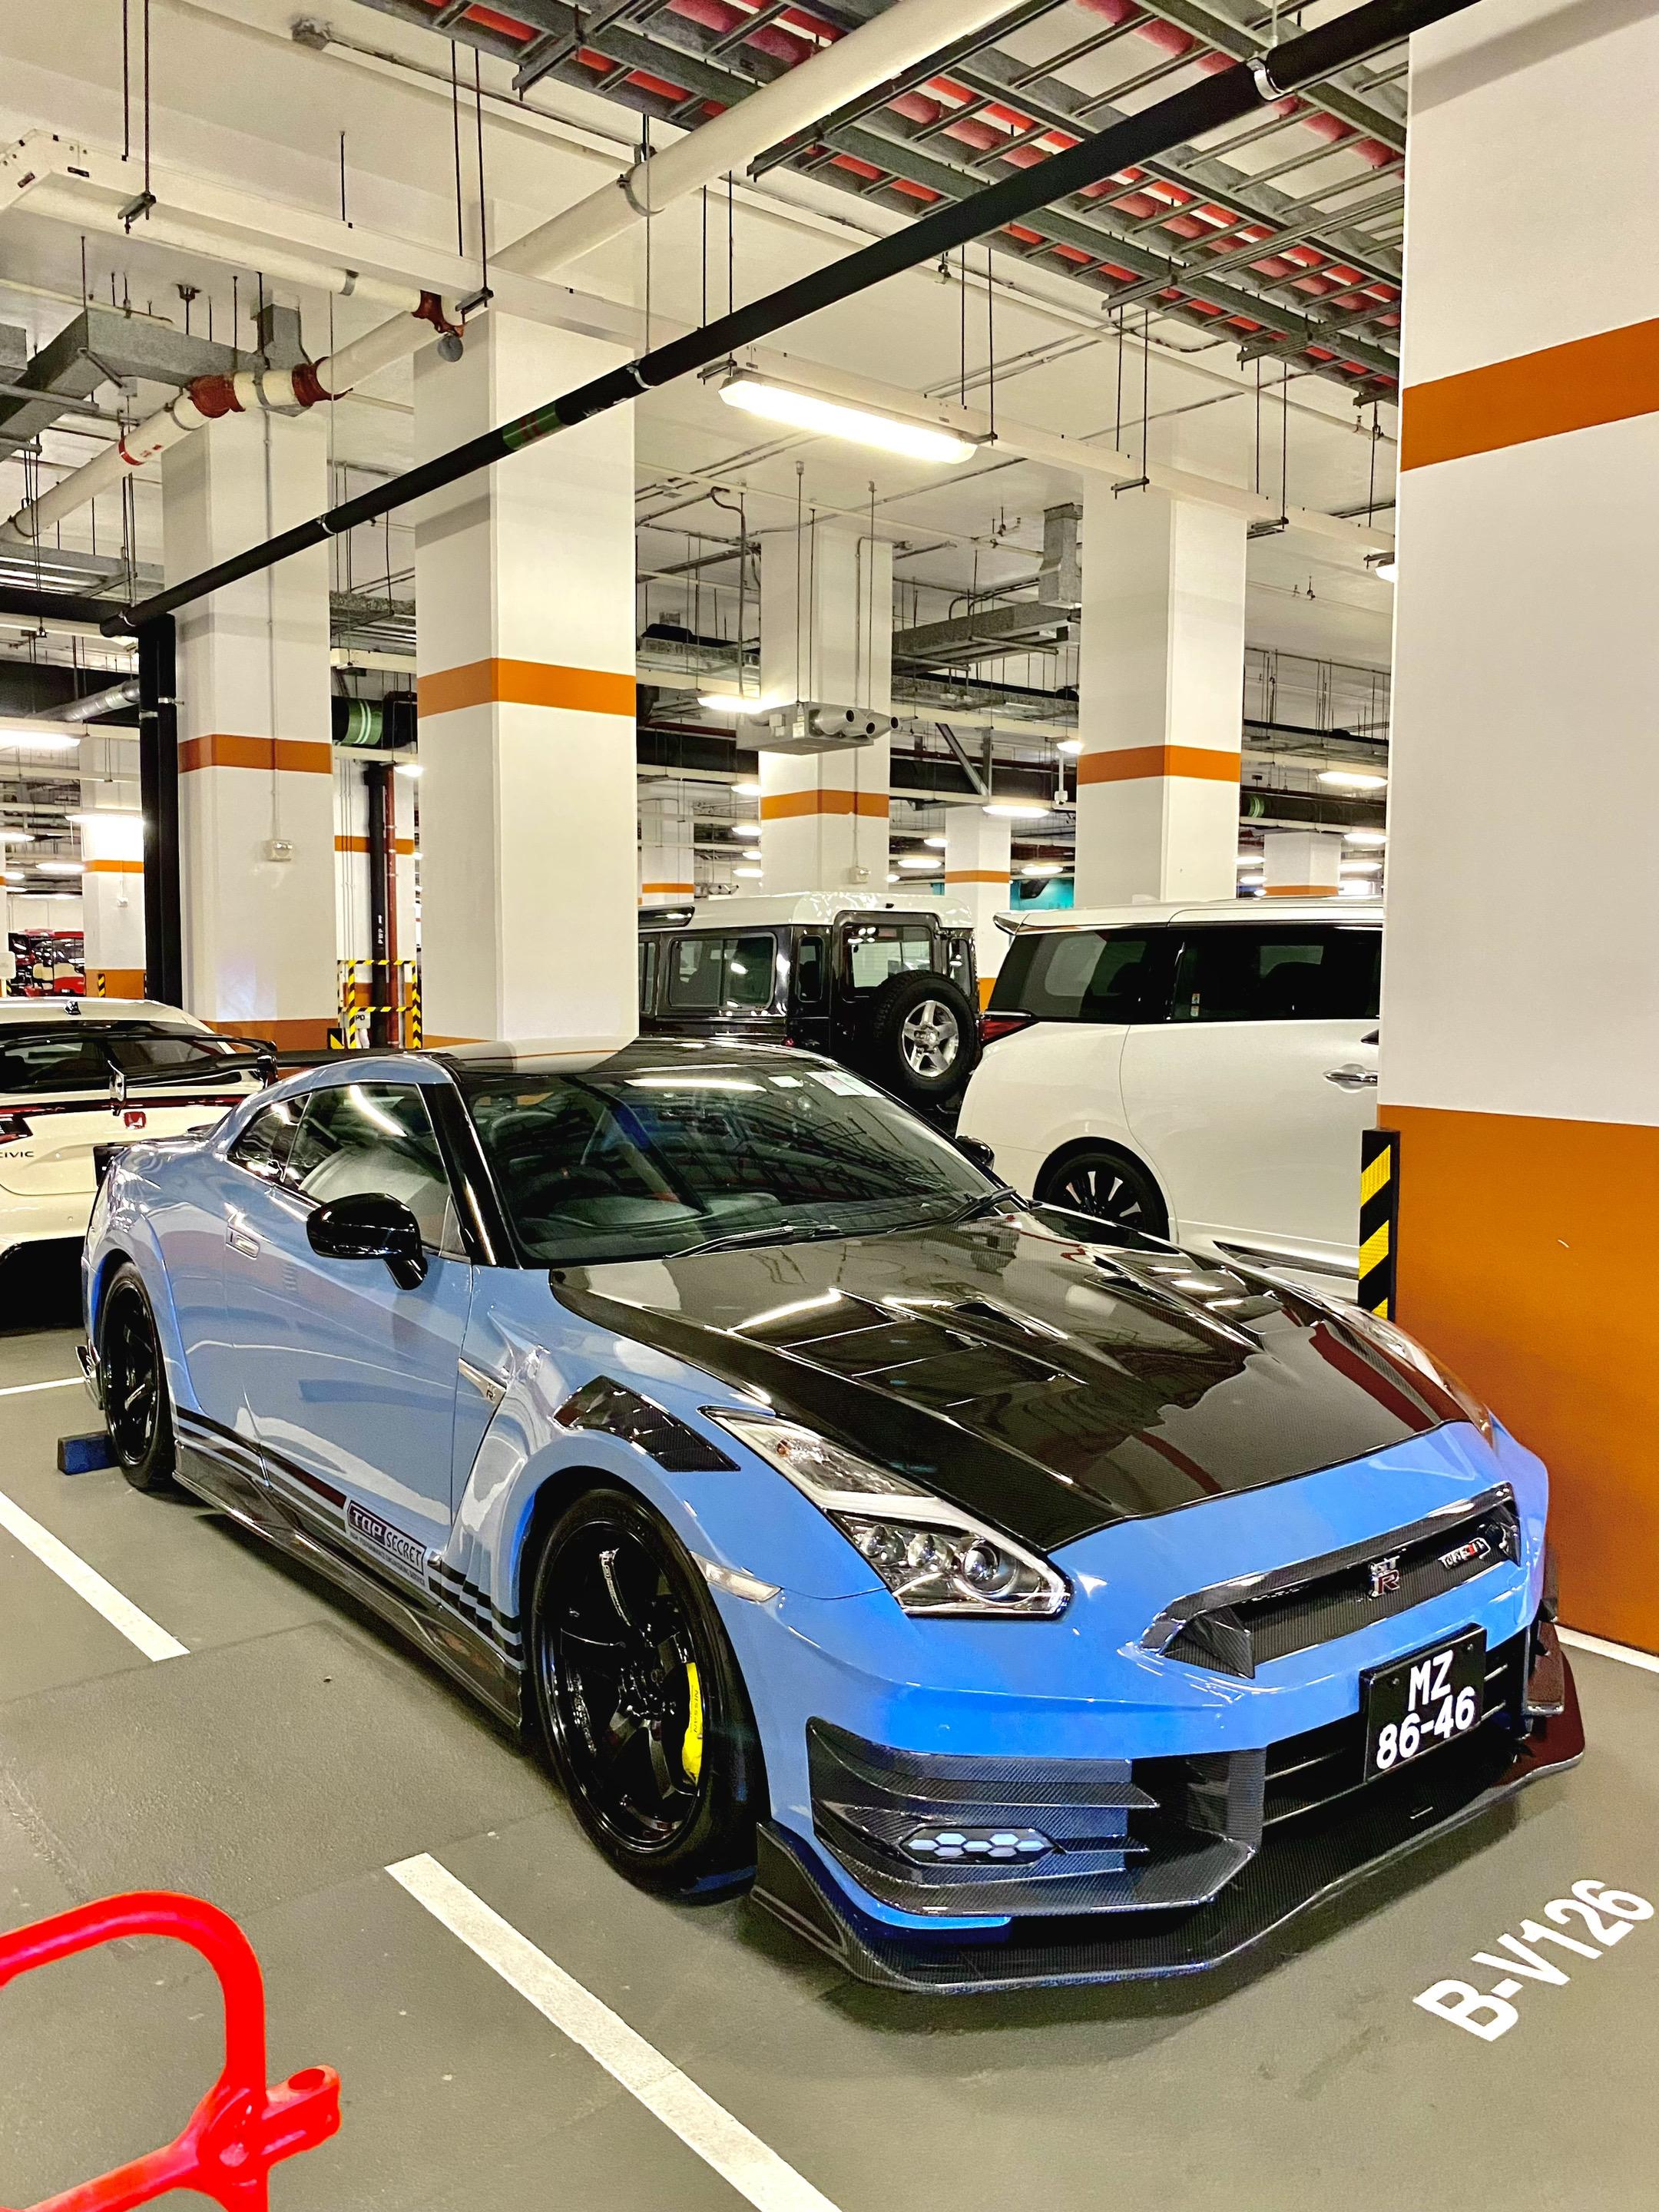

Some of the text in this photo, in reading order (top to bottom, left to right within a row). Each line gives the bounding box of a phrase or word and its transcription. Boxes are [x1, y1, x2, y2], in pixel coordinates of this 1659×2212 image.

[353, 1510, 383, 1538] TOP
[386, 1531, 422, 1567] SECRET
[1371, 1568, 1400, 1597] R
[1407, 1649, 1454, 1712] MZ
[1376, 1685, 1475, 1770] 86-46
[1412, 1879, 1655, 2042] B-V126
